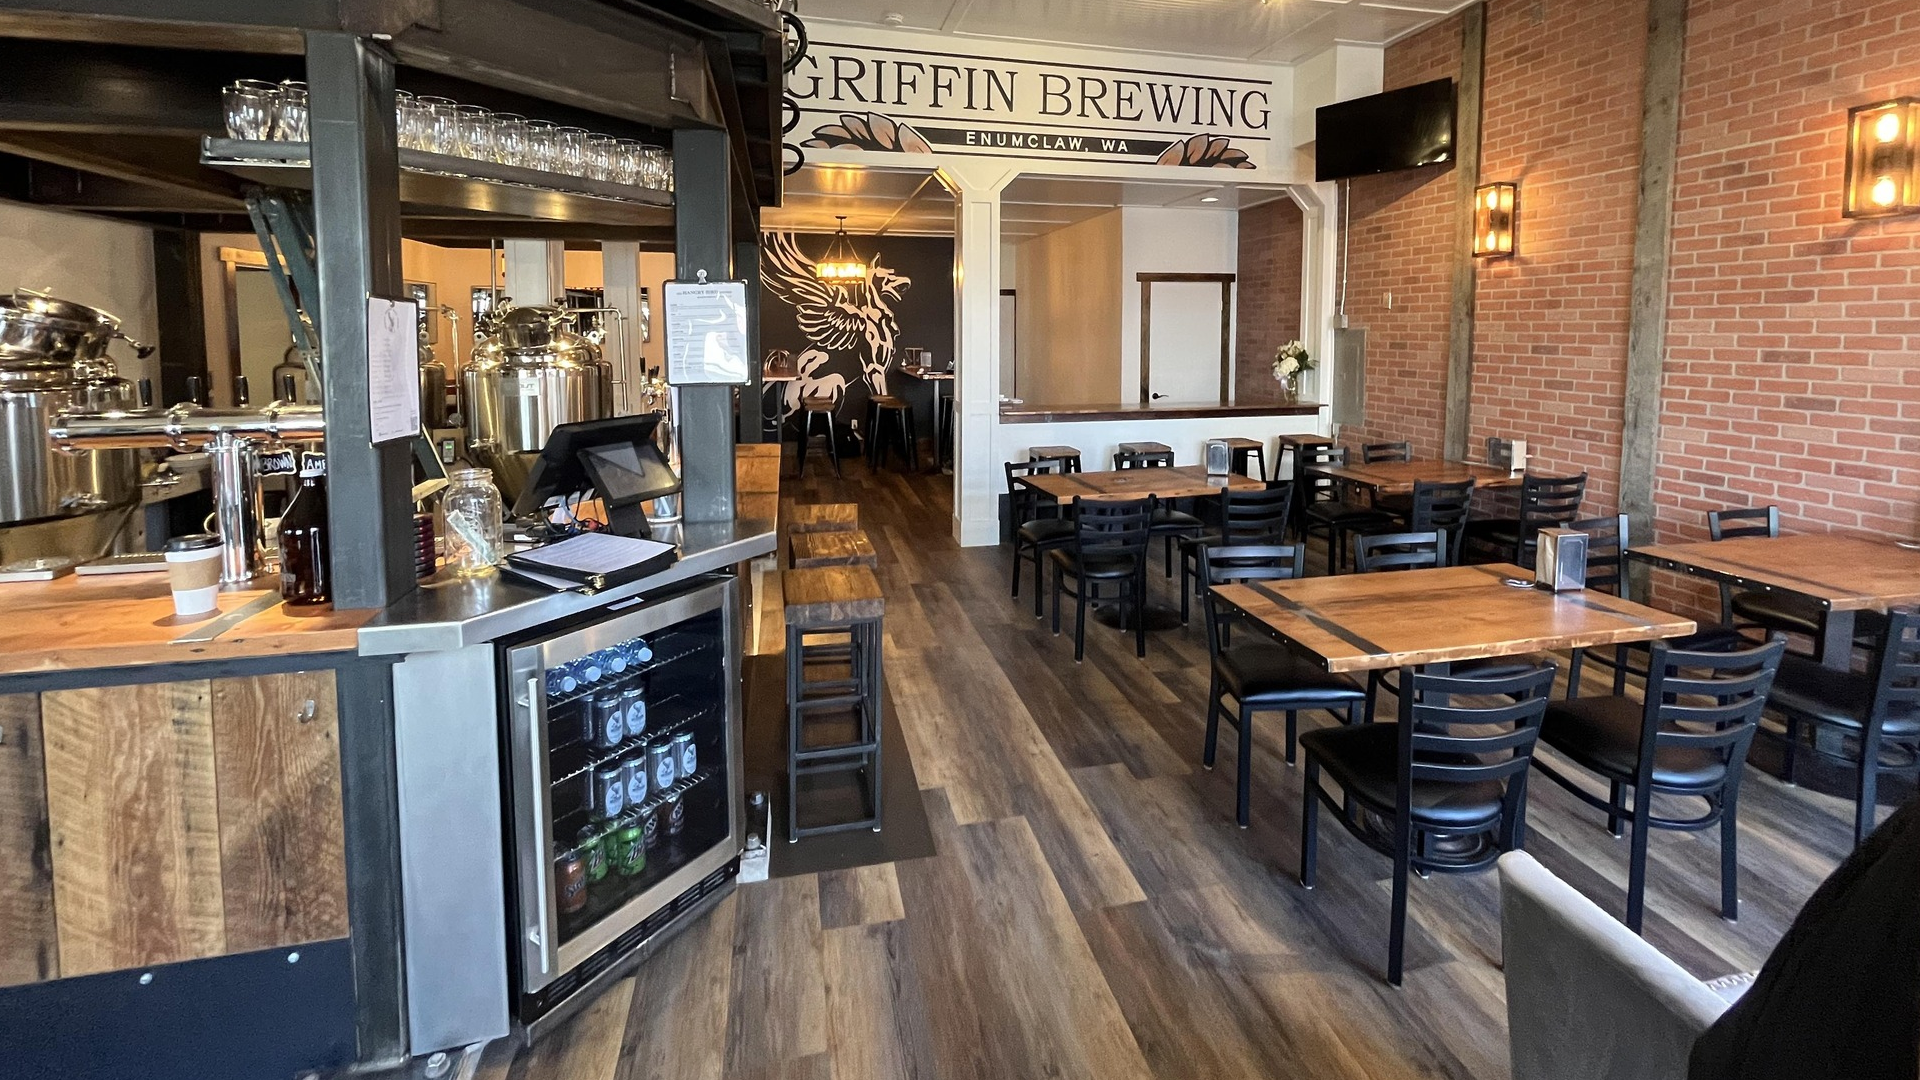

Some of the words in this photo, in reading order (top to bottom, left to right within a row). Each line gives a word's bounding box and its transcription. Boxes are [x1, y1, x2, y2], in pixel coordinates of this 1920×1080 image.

[786, 54, 1018, 112] GRIFFIN
[1038, 73, 1272, 131] BREWING
[965, 131, 1089, 153] ENUMCLAW,
[1101, 138, 1129, 153] WA
[262, 453, 293, 472] BROWN
